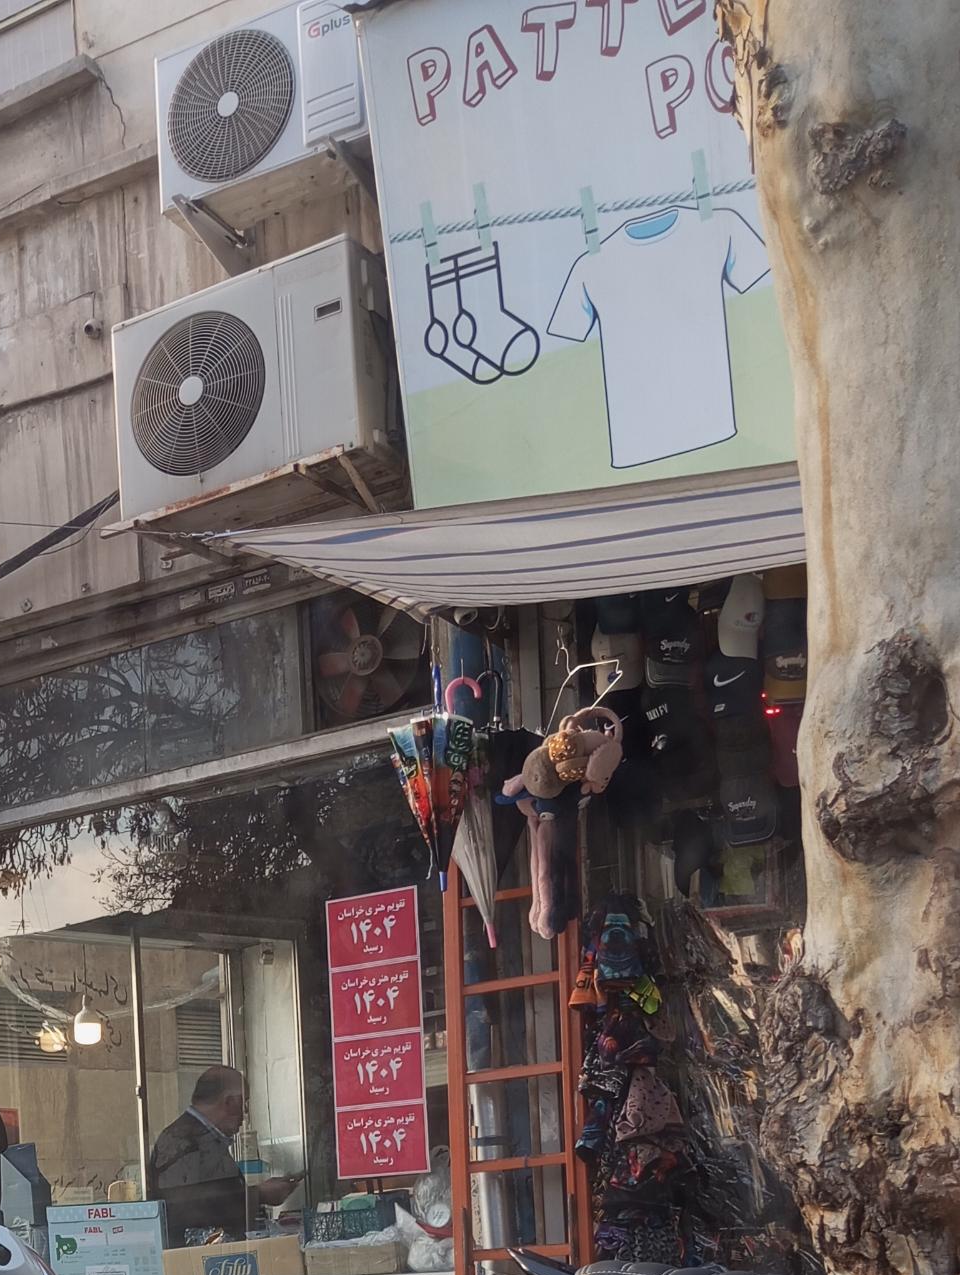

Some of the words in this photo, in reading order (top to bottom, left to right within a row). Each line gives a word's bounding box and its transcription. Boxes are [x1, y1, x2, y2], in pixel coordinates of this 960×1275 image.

[308, 15, 350, 38] Gplus
[365, 904, 385, 916] هنری
[387, 899, 406, 912] تقویم
[337, 906, 364, 920] خراسان
[351, 915, 396, 944] ۱۴۰۴
[363, 944, 383, 953] رسید
[341, 977, 368, 990] خراسان
[369, 976, 389, 986] هنری
[390, 970, 409, 984] تقویم
[354, 986, 399, 1015] ۱۴۰۴
[367, 1015, 387, 1024] رسید
[344, 1047, 370, 1060] خراسان
[371, 1047, 391, 1058] هنری
[393, 1042, 412, 1054] تقویم
[357, 1057, 402, 1085] ۱۴۰۴
[369, 1085, 390, 1095] رسید
[347, 1118, 374, 1130] خراسان
[374, 1117, 395, 1128] هنری
[397, 1113, 415, 1126] تقویم
[360, 1128, 406, 1154] ۱۴۰۴
[373, 1156, 394, 1165] رسید
[87, 1207, 116, 1220] FABL
